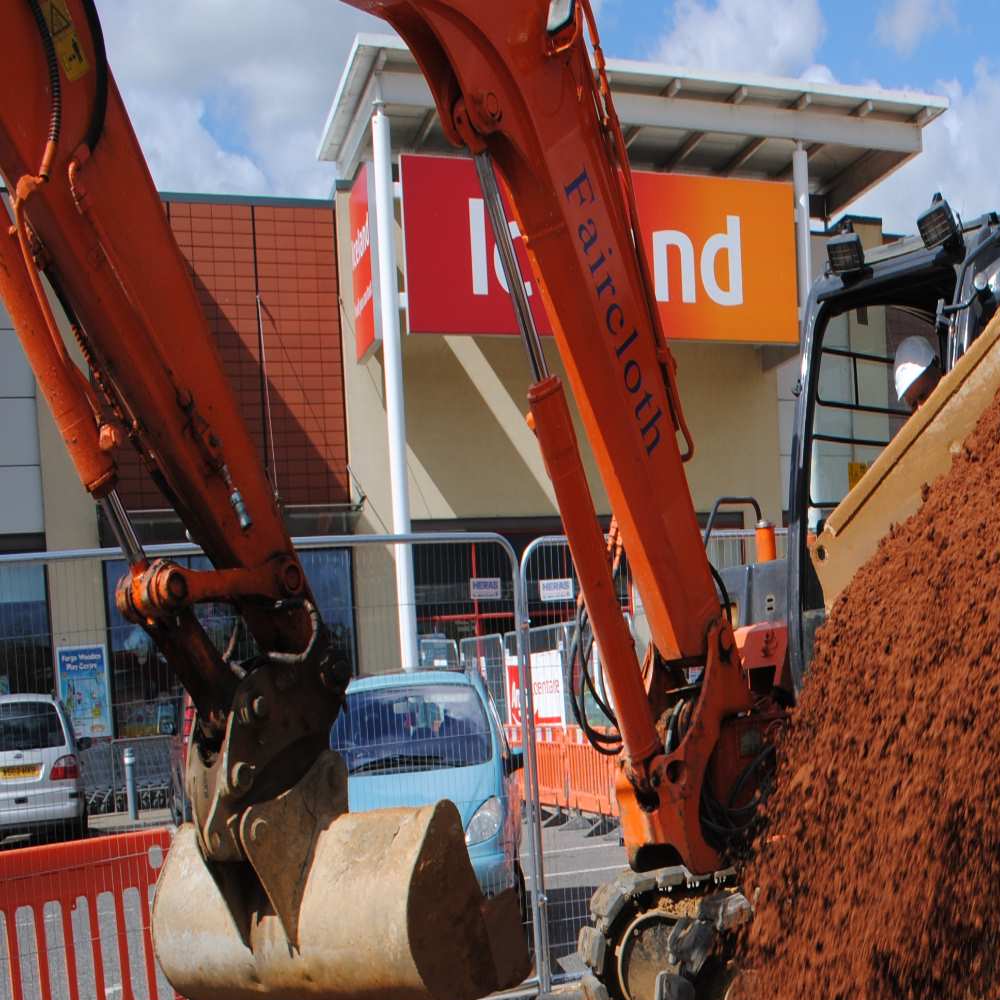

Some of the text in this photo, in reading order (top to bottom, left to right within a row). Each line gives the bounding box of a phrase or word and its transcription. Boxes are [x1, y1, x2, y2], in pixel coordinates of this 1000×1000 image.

[468, 197, 744, 307] Icnd
[563, 168, 663, 456] Faircloth
[473, 580, 498, 590] HERAS
[543, 580, 570, 592] HERAS
